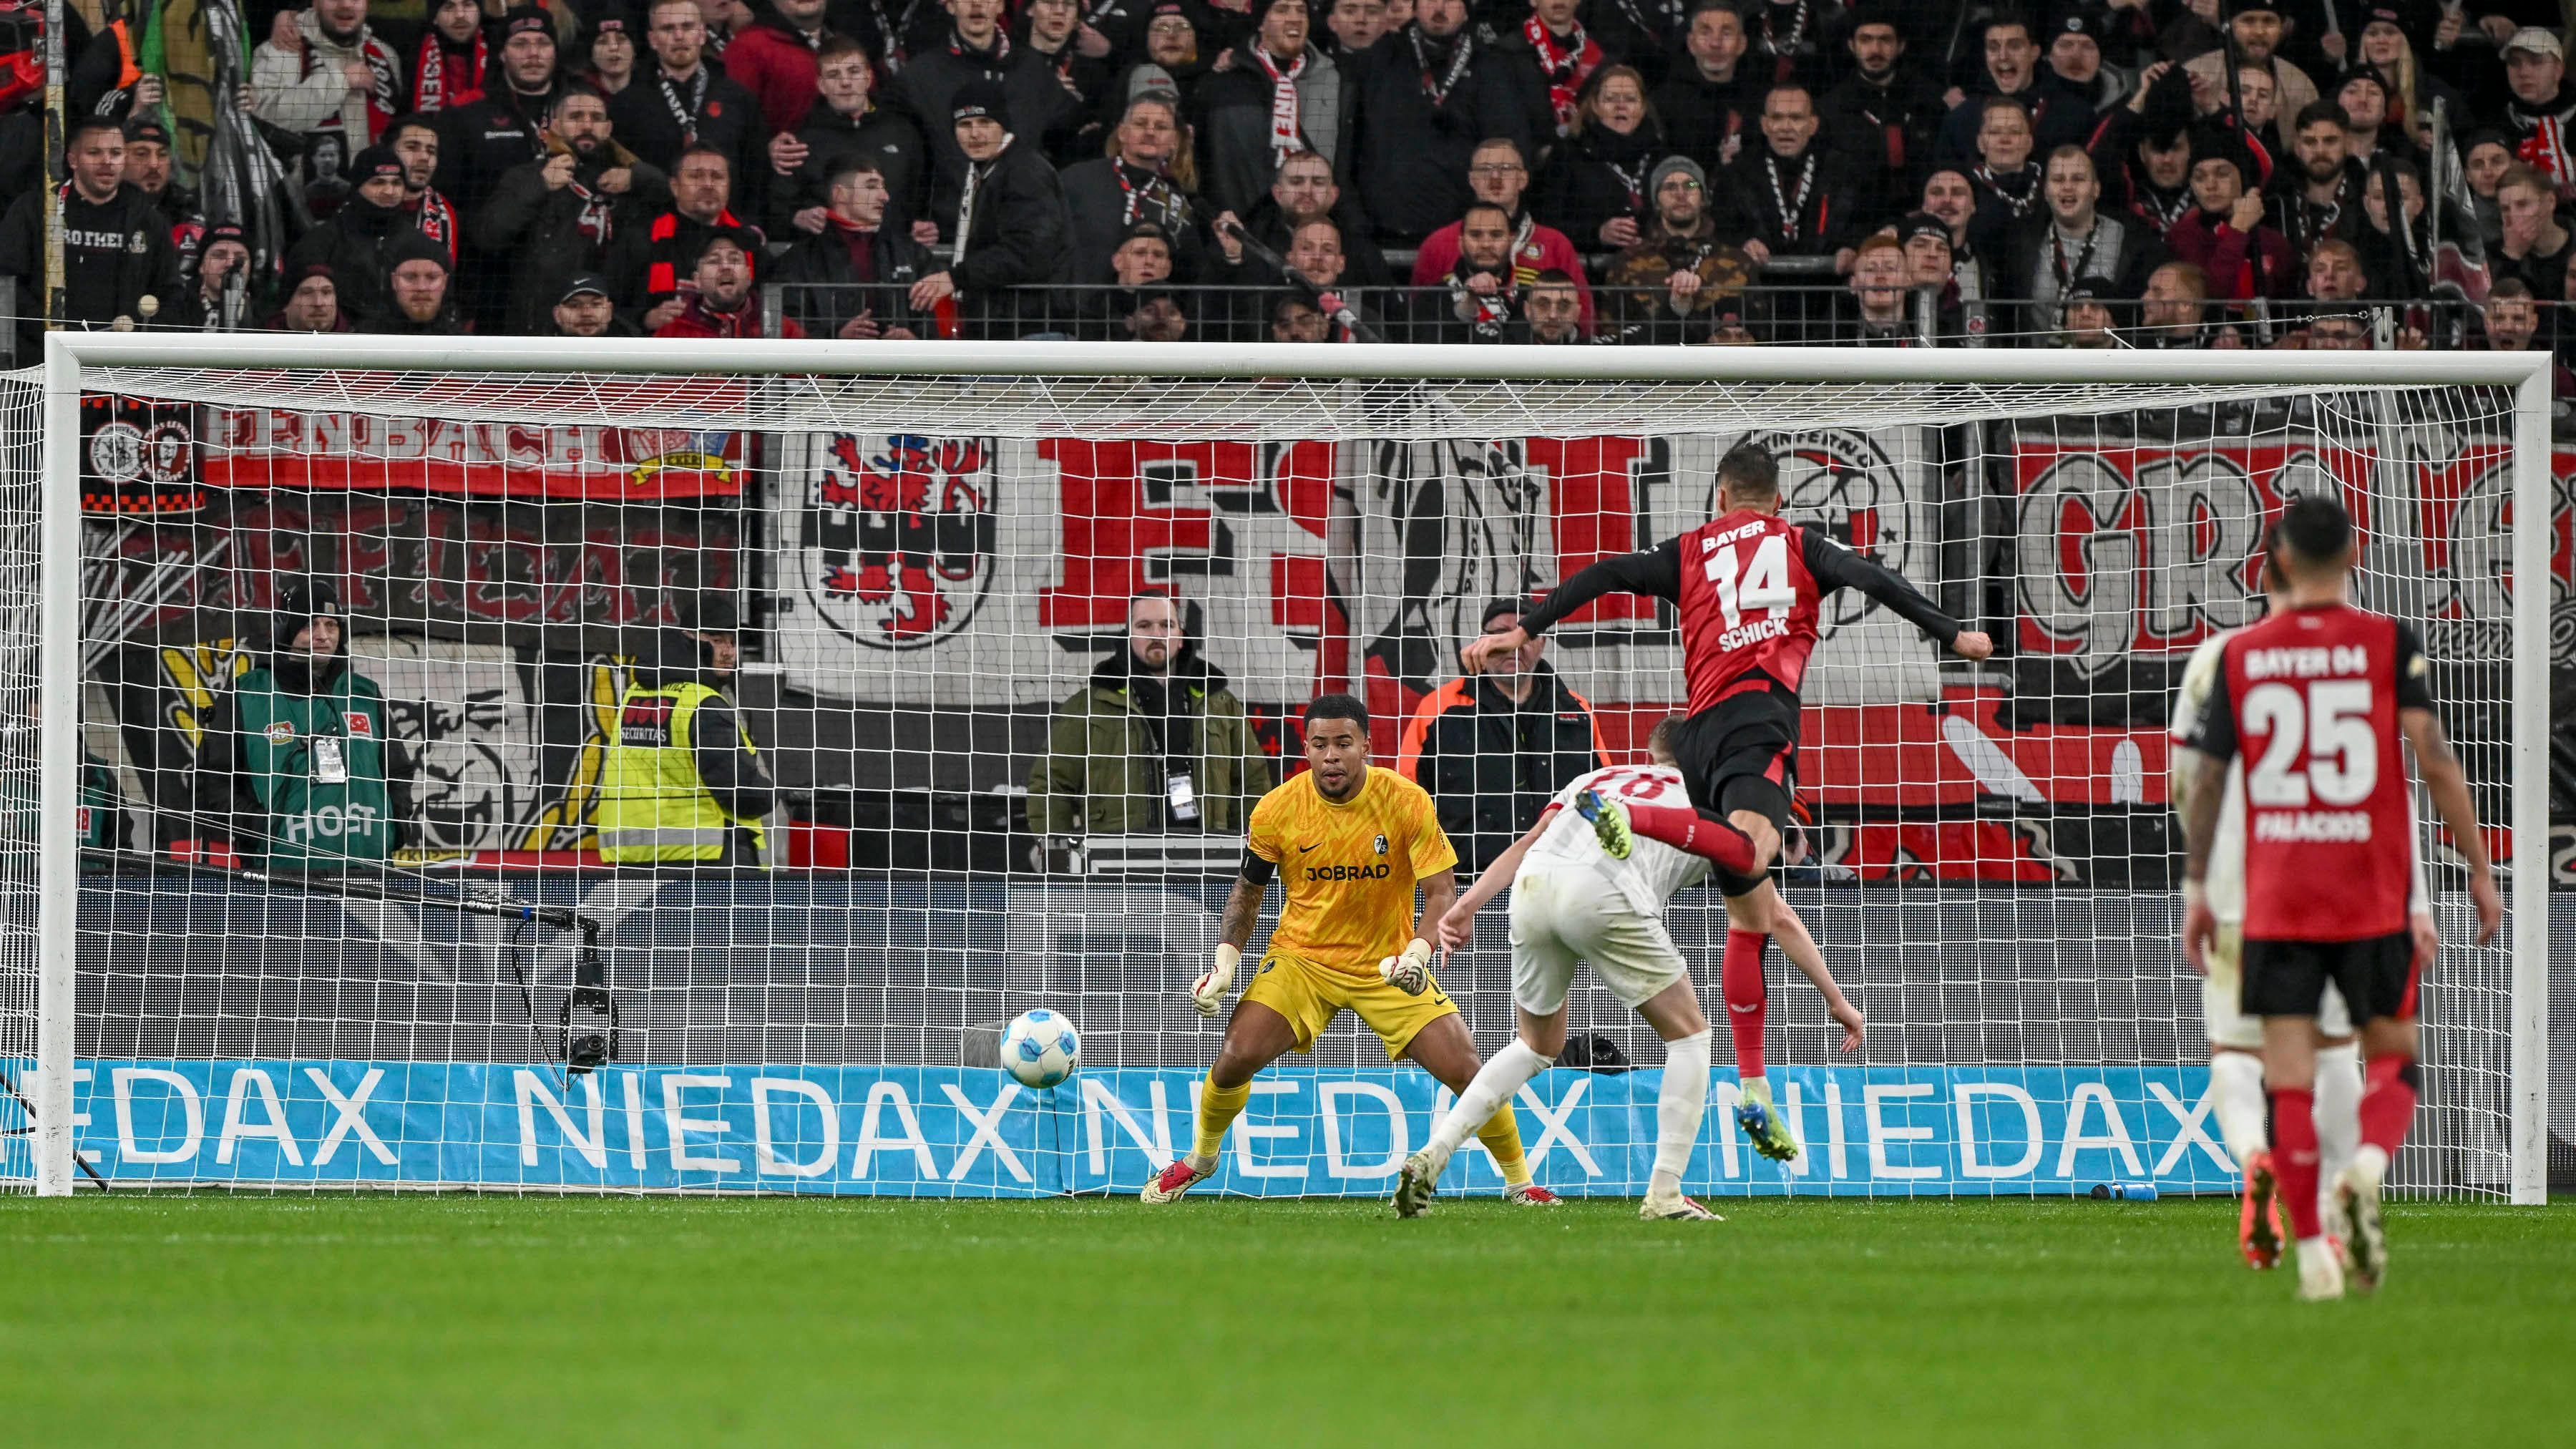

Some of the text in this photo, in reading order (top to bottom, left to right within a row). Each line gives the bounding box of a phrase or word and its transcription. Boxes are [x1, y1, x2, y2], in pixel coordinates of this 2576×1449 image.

[1702, 519, 1766, 554] BAYER
[1704, 535, 1797, 631] 14
[1719, 617, 1790, 653] SCHICK
[2244, 645, 2368, 678] BAYER 04
[620, 726, 667, 743] SECURITAS
[2241, 680, 2379, 807] 25
[286, 801, 376, 842] HOST
[2254, 811, 2372, 842] PALACIOS
[1306, 864, 1390, 882] JOBRAD
[0, 1068, 1034, 1182] EDAX NIEDAX
[1717, 1082, 2240, 1179] NIEDAX
